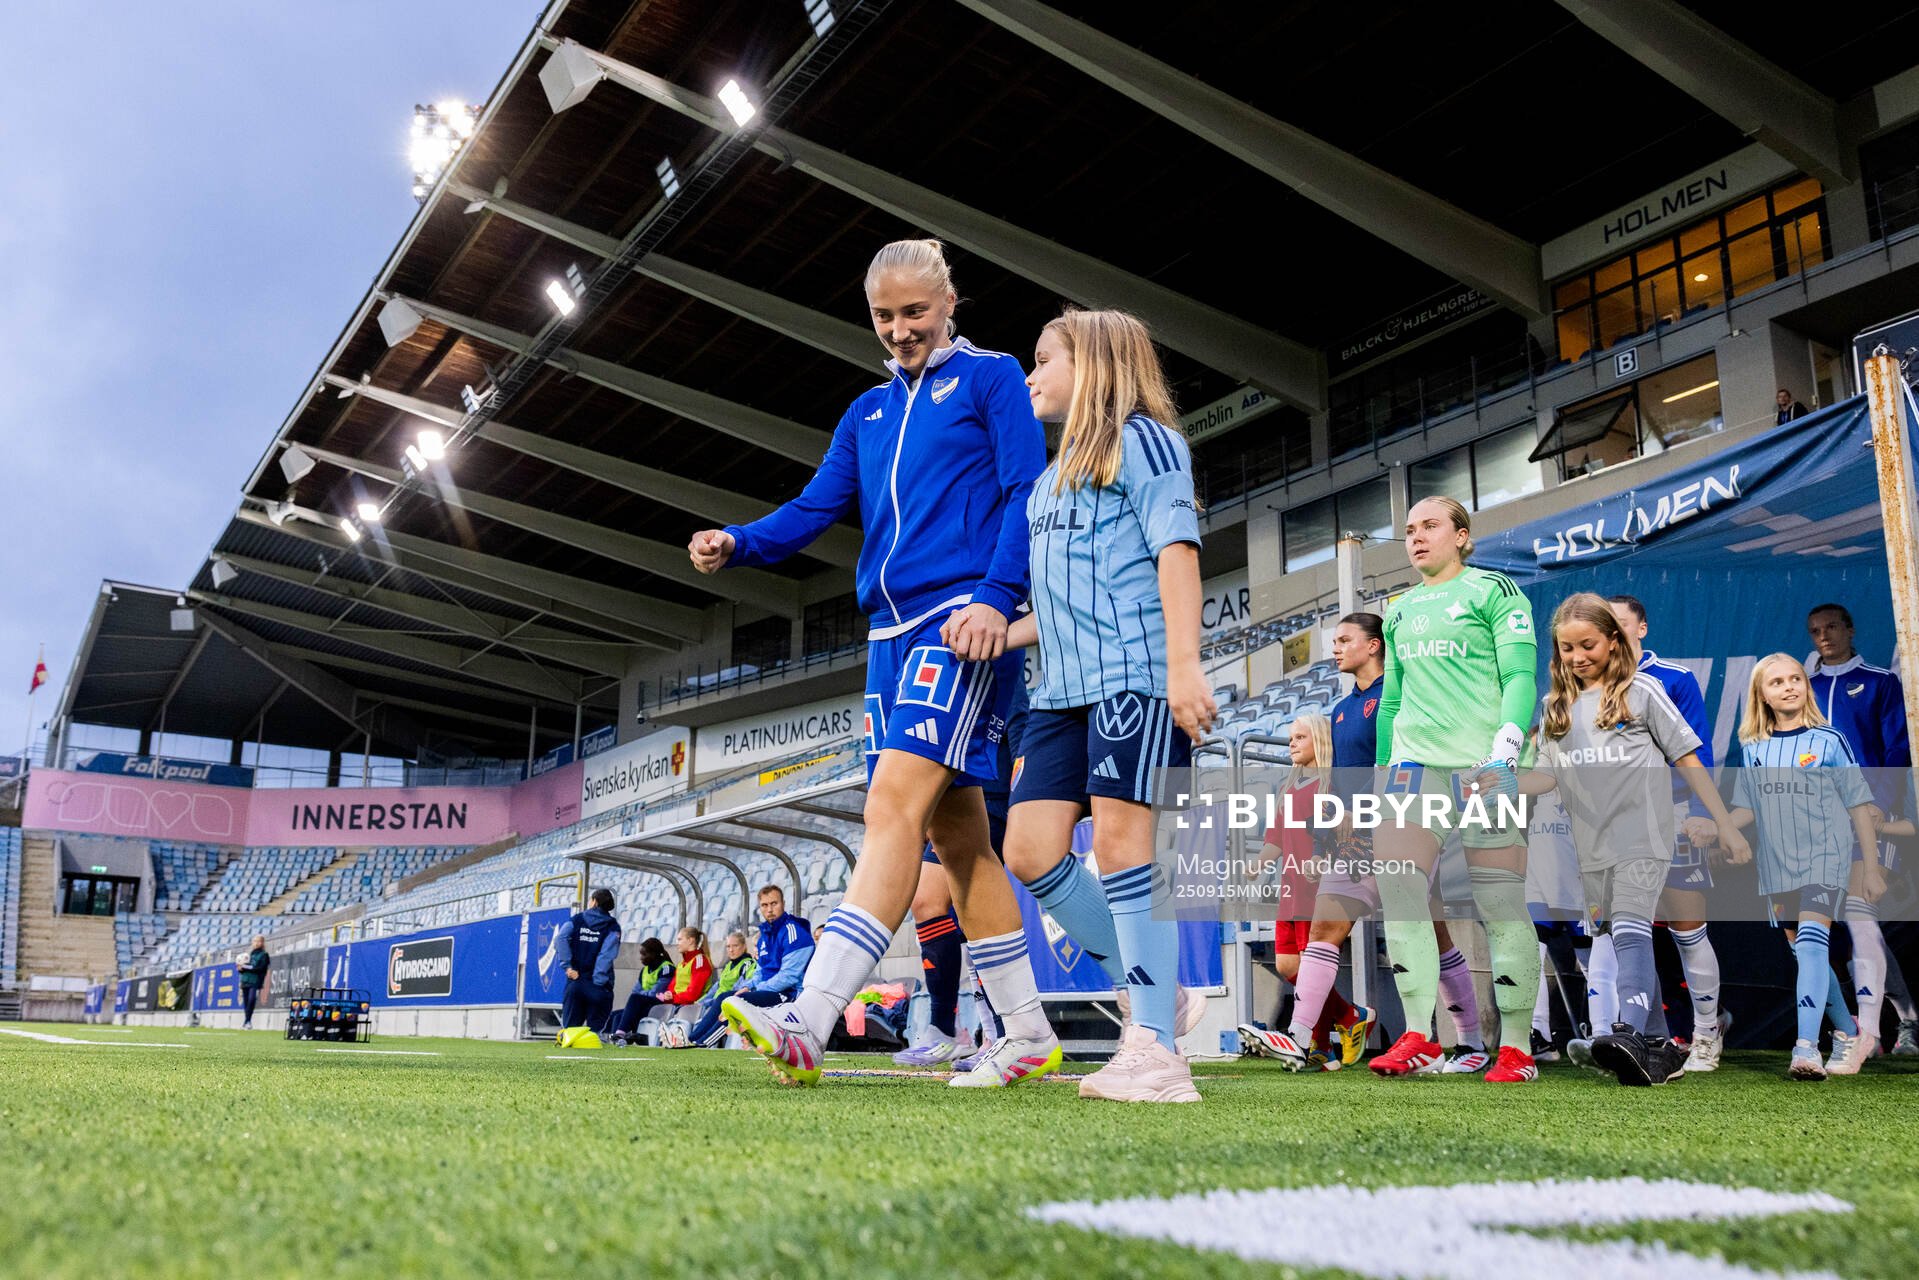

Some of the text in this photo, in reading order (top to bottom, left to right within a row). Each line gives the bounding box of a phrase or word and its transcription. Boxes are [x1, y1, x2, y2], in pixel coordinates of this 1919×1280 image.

[1603, 168, 1729, 245] HOLMEN
[1341, 332, 1384, 361] BALCK
[1618, 352, 1635, 373] B
[1182, 403, 1234, 437] emblin
[1533, 464, 1742, 561] HOLMEN
[724, 709, 852, 756] PLATINUMCARS
[123, 757, 212, 780] Folkpool
[583, 754, 669, 802] Svenska kyrkan
[292, 802, 468, 830] INNERSTAN
[395, 957, 450, 981] HYDROSCAND
